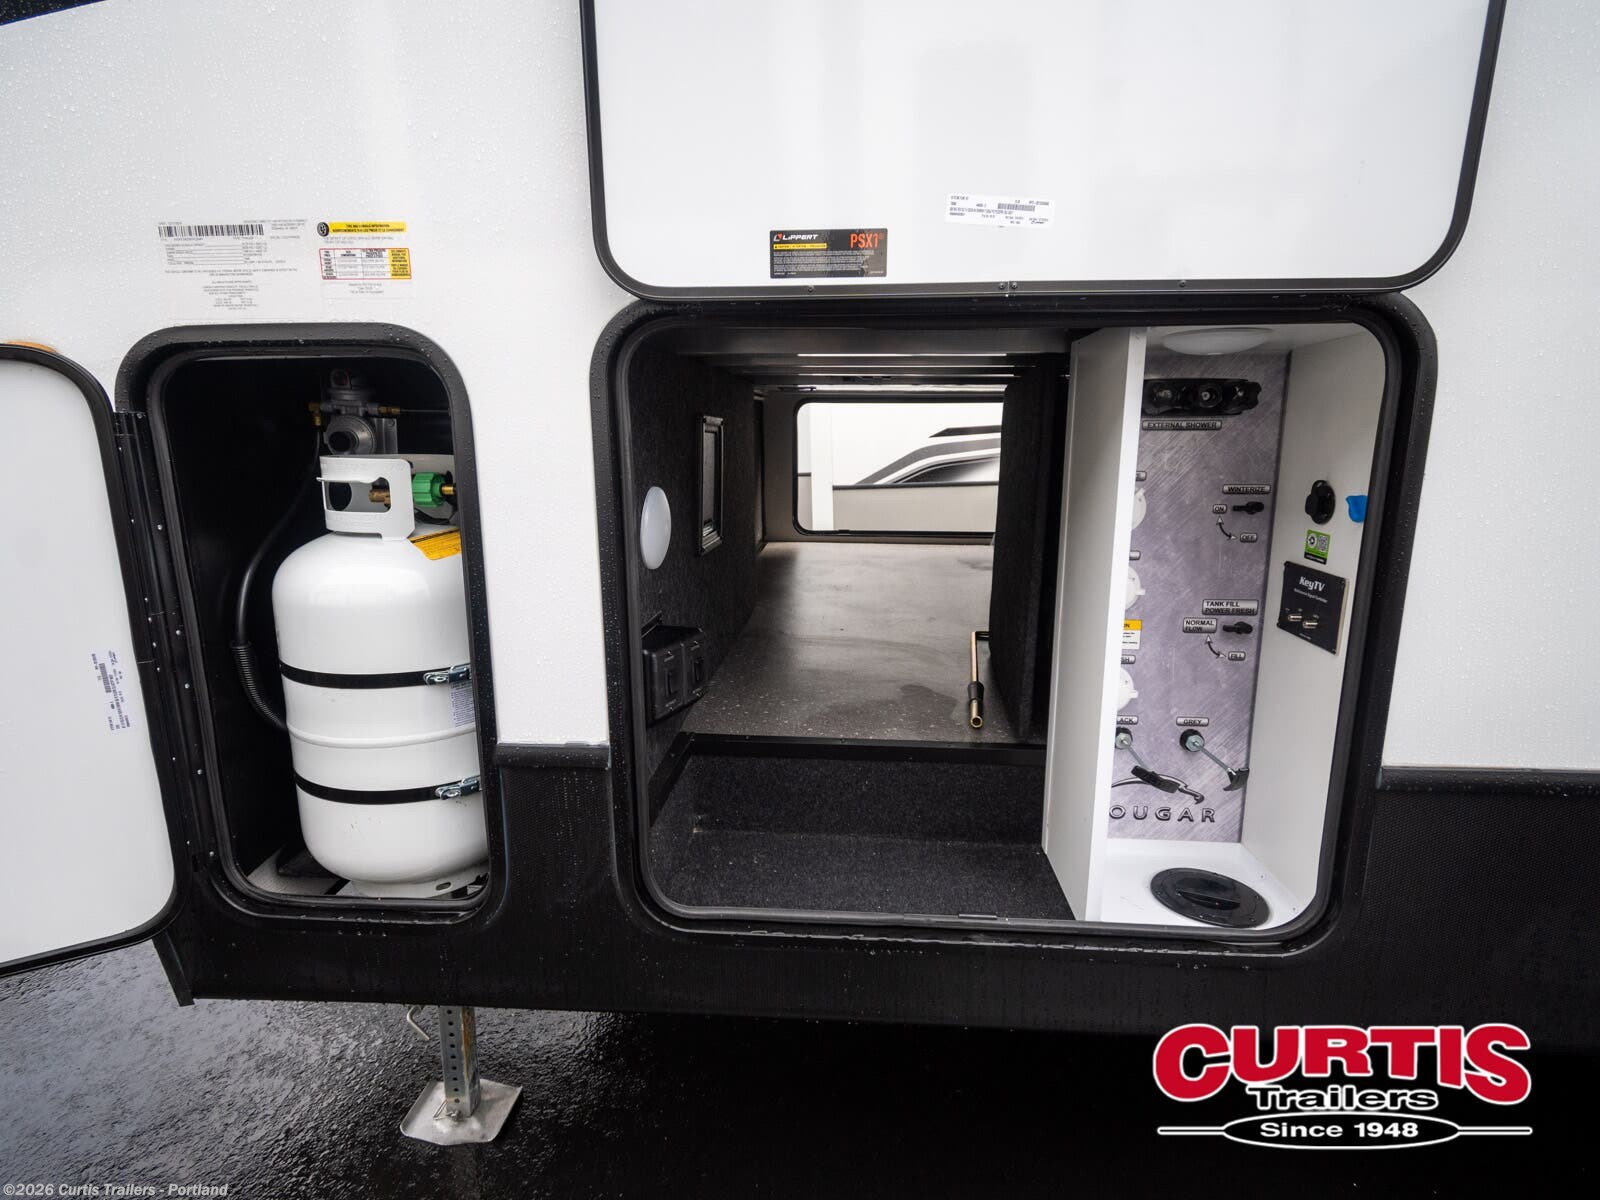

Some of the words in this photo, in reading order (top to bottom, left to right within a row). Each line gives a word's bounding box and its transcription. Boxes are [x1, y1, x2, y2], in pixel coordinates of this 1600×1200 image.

[1147, 421, 1183, 429] EXTERNAL
[1185, 421, 1217, 429] SHOWER
[1299, 576, 1325, 592] KeyTV
